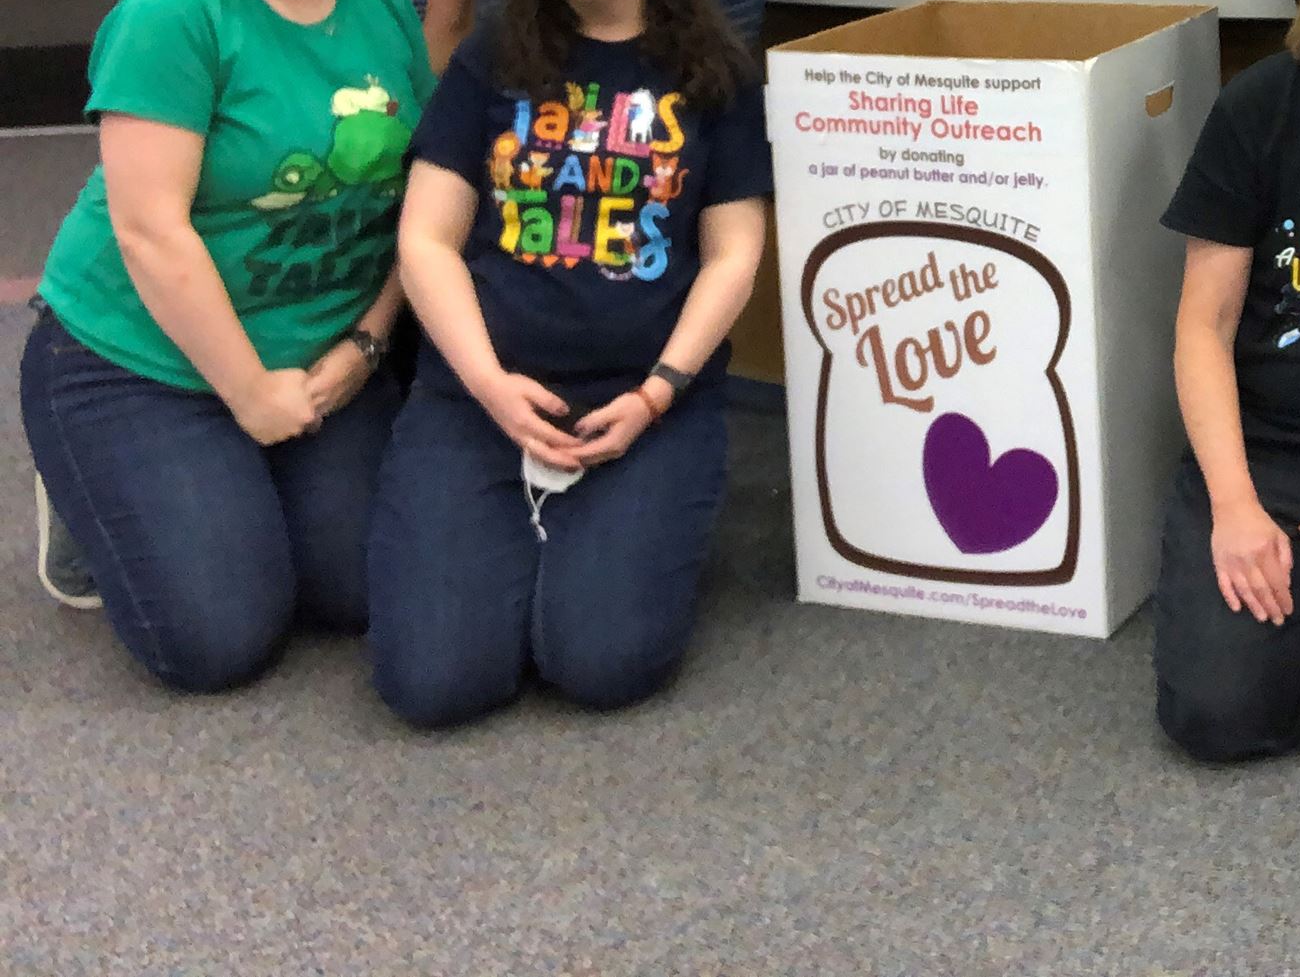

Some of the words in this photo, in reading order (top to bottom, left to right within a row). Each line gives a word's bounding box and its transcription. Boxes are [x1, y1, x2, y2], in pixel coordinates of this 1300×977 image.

[804, 68, 836, 84] Help
[840, 70, 861, 85] the
[865, 71, 892, 88] City
[897, 72, 910, 87] of
[914, 74, 980, 91] Mesquite
[984, 75, 1042, 91] support
[849, 90, 932, 118] Sharing
[940, 95, 979, 116] Life
[795, 111, 922, 142] Community
[930, 119, 1042, 142] Outreach
[879, 146, 897, 161] by
[901, 148, 965, 167] donating
[553, 155, 640, 194] AND
[809, 163, 818, 175] a
[820, 162, 839, 177] jar
[843, 163, 857, 177] of
[860, 166, 910, 182] peanut
[914, 166, 955, 183] butter
[959, 169, 1009, 186] and/or
[822, 201, 870, 229] CITY
[879, 199, 907, 218] OF
[915, 200, 1041, 243] MESQUITE
[1275, 247, 1295, 268] A
[822, 250, 945, 336] Spread
[949, 261, 999, 302] the
[855, 309, 997, 413] Love
